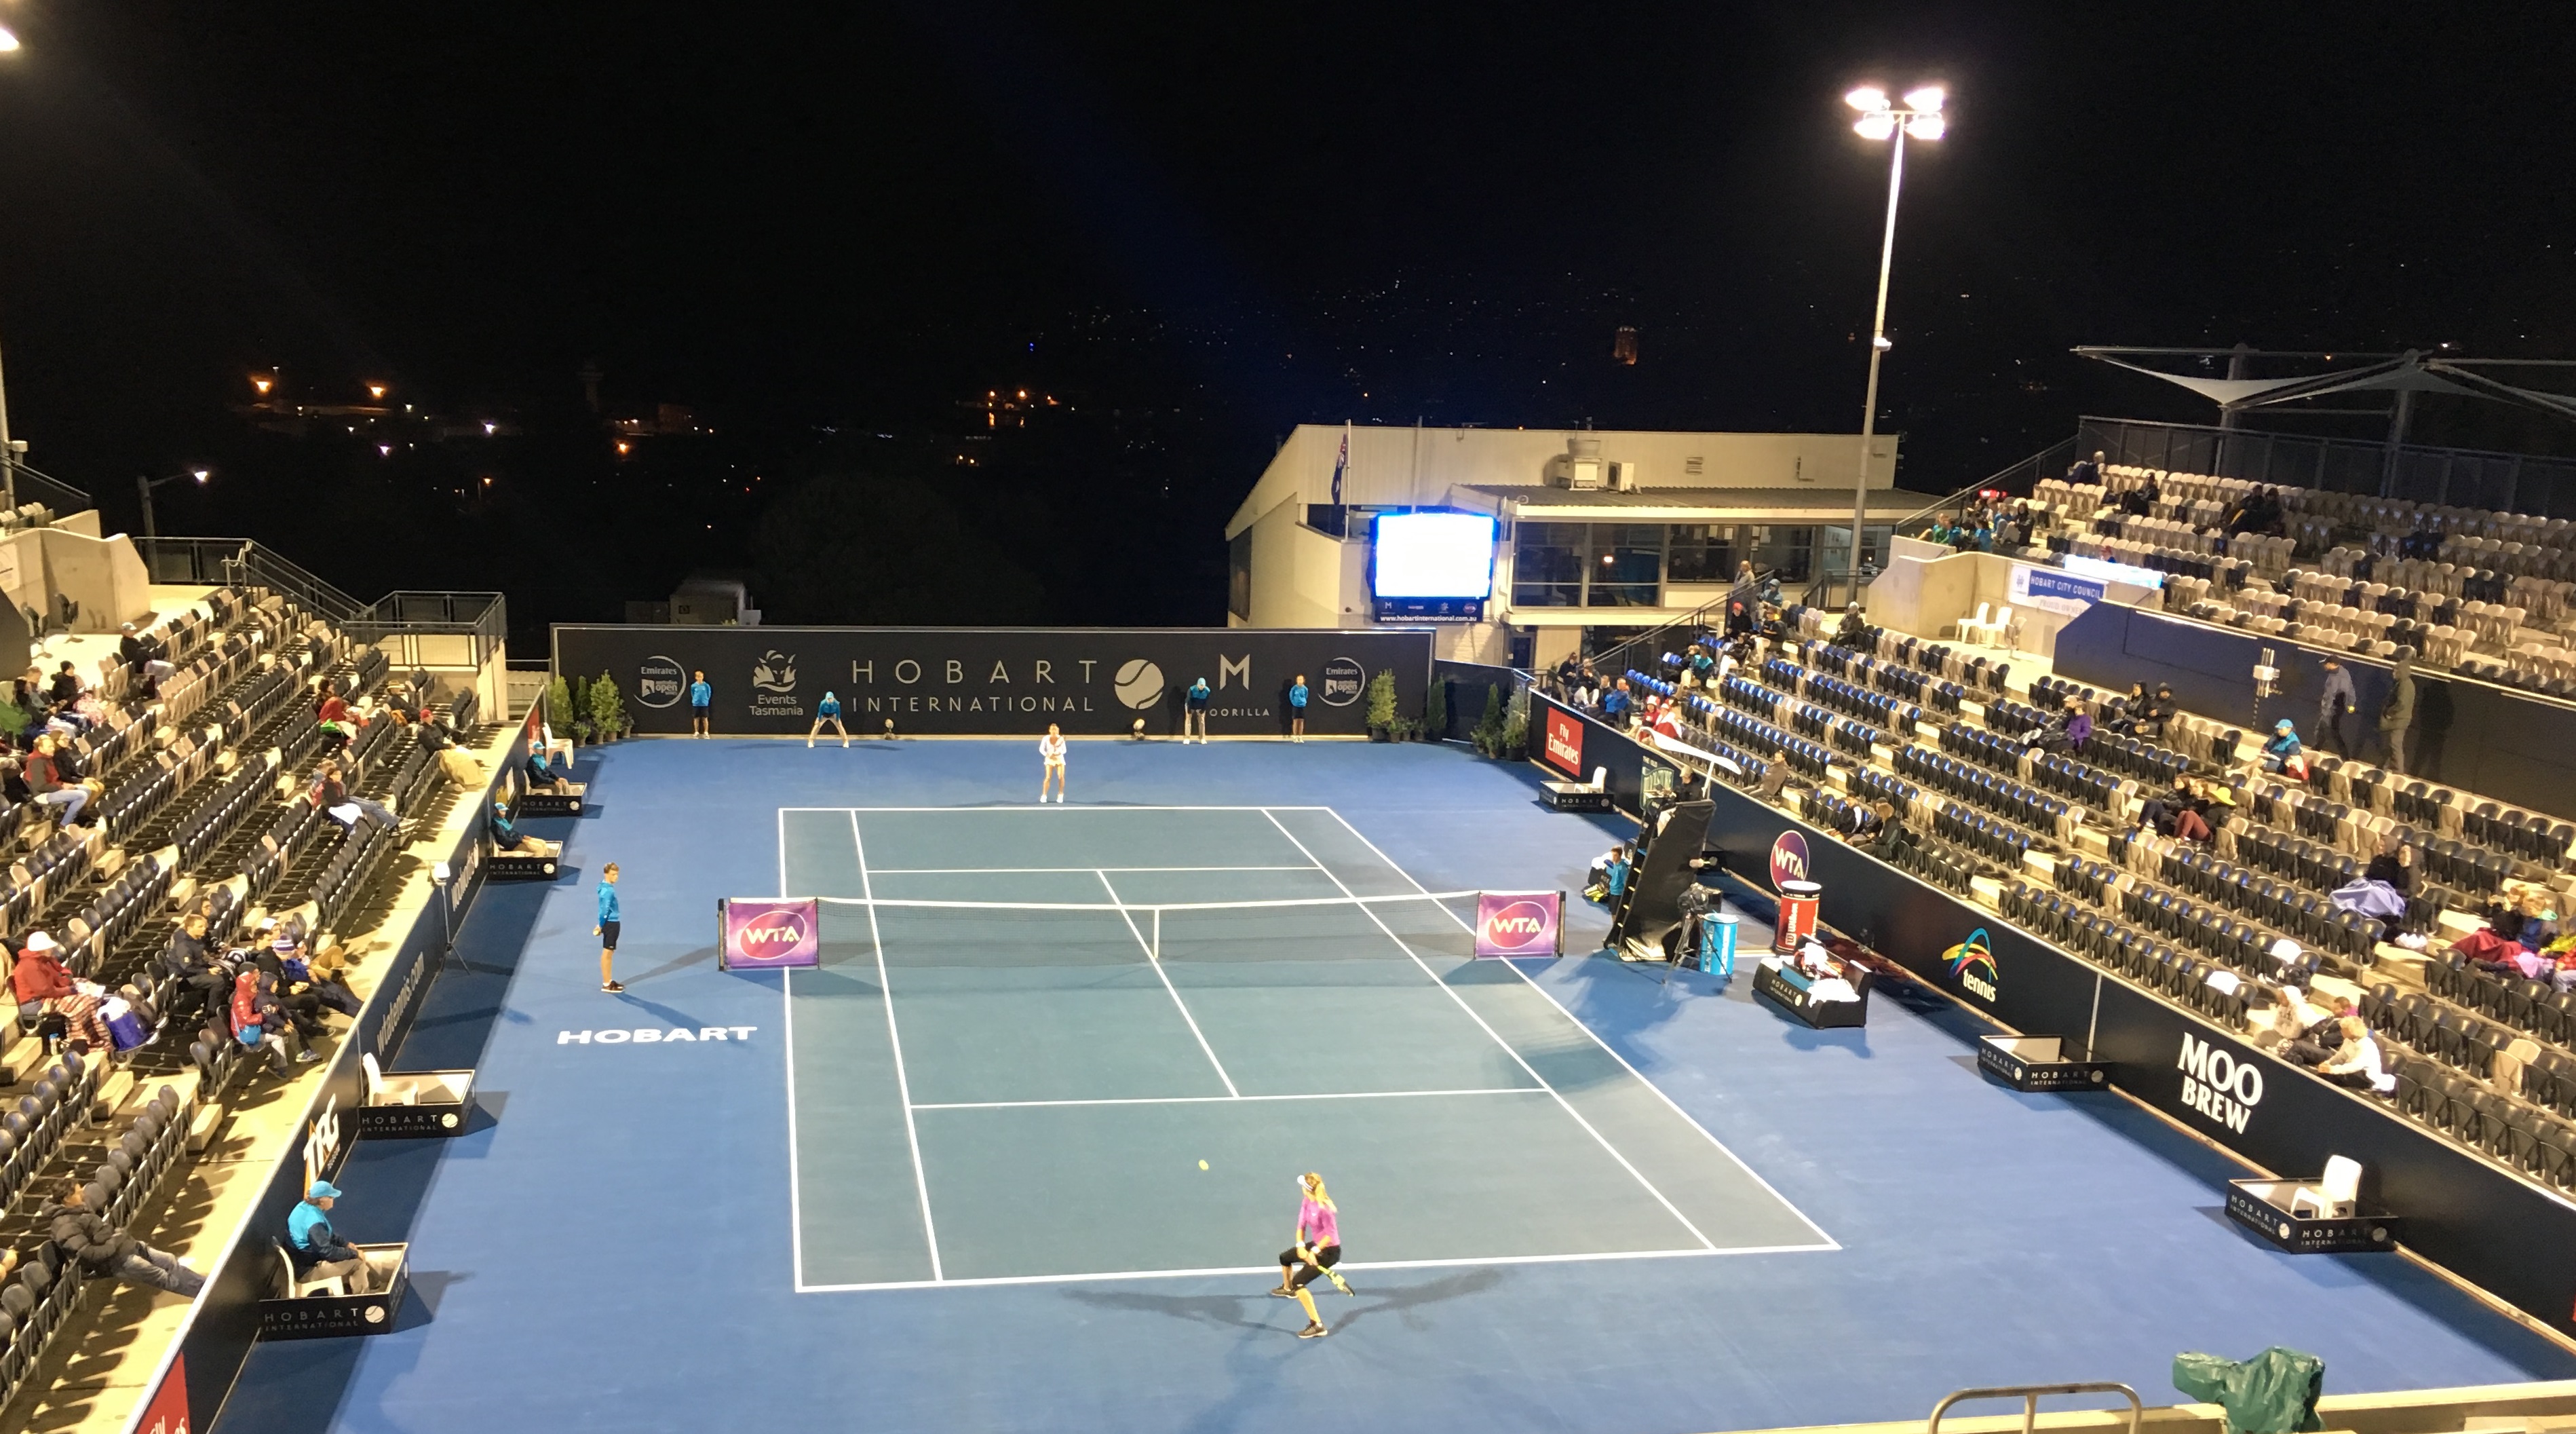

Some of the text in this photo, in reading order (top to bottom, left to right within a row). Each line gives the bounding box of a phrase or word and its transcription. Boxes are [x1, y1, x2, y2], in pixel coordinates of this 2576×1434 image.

[2031, 576, 2100, 599] HOBART CITY COUNCIL
[640, 666, 677, 675] Emirates
[852, 660, 1097, 684] HOBART
[1219, 654, 1250, 690] M
[1326, 667, 1358, 675] Emirates
[655, 684, 678, 693] open
[1337, 684, 1358, 692] open
[758, 694, 797, 704] Events
[853, 697, 1094, 712] INTERNATIONAL
[749, 706, 803, 716] Tasmania
[1209, 708, 1270, 717] OORILLA
[1560, 723, 1569, 742] Fly
[1548, 733, 1579, 766] Emirates
[1775, 845, 1804, 880] WTA
[1493, 917, 1541, 934] WTA
[746, 926, 800, 944] WTA
[1963, 968, 1996, 1002] tennis
[557, 1026, 758, 1044] HOBART
[1982, 1048, 2014, 1070] HOBART
[2031, 1071, 2090, 1079] HOBART
[2177, 1032, 2263, 1106] MOO
[2181, 1075, 2252, 1135] BREW
[362, 1114, 438, 1125] HOBART
[303, 1093, 339, 1186] TPG
[2231, 1194, 2278, 1226] HOBART
[2229, 1204, 2275, 1235] INTERNATIONAL
[2302, 1228, 2368, 1238] HOBART
[265, 1308, 358, 1322] HOBART
[265, 1320, 358, 1332] INTERNATIONAL
